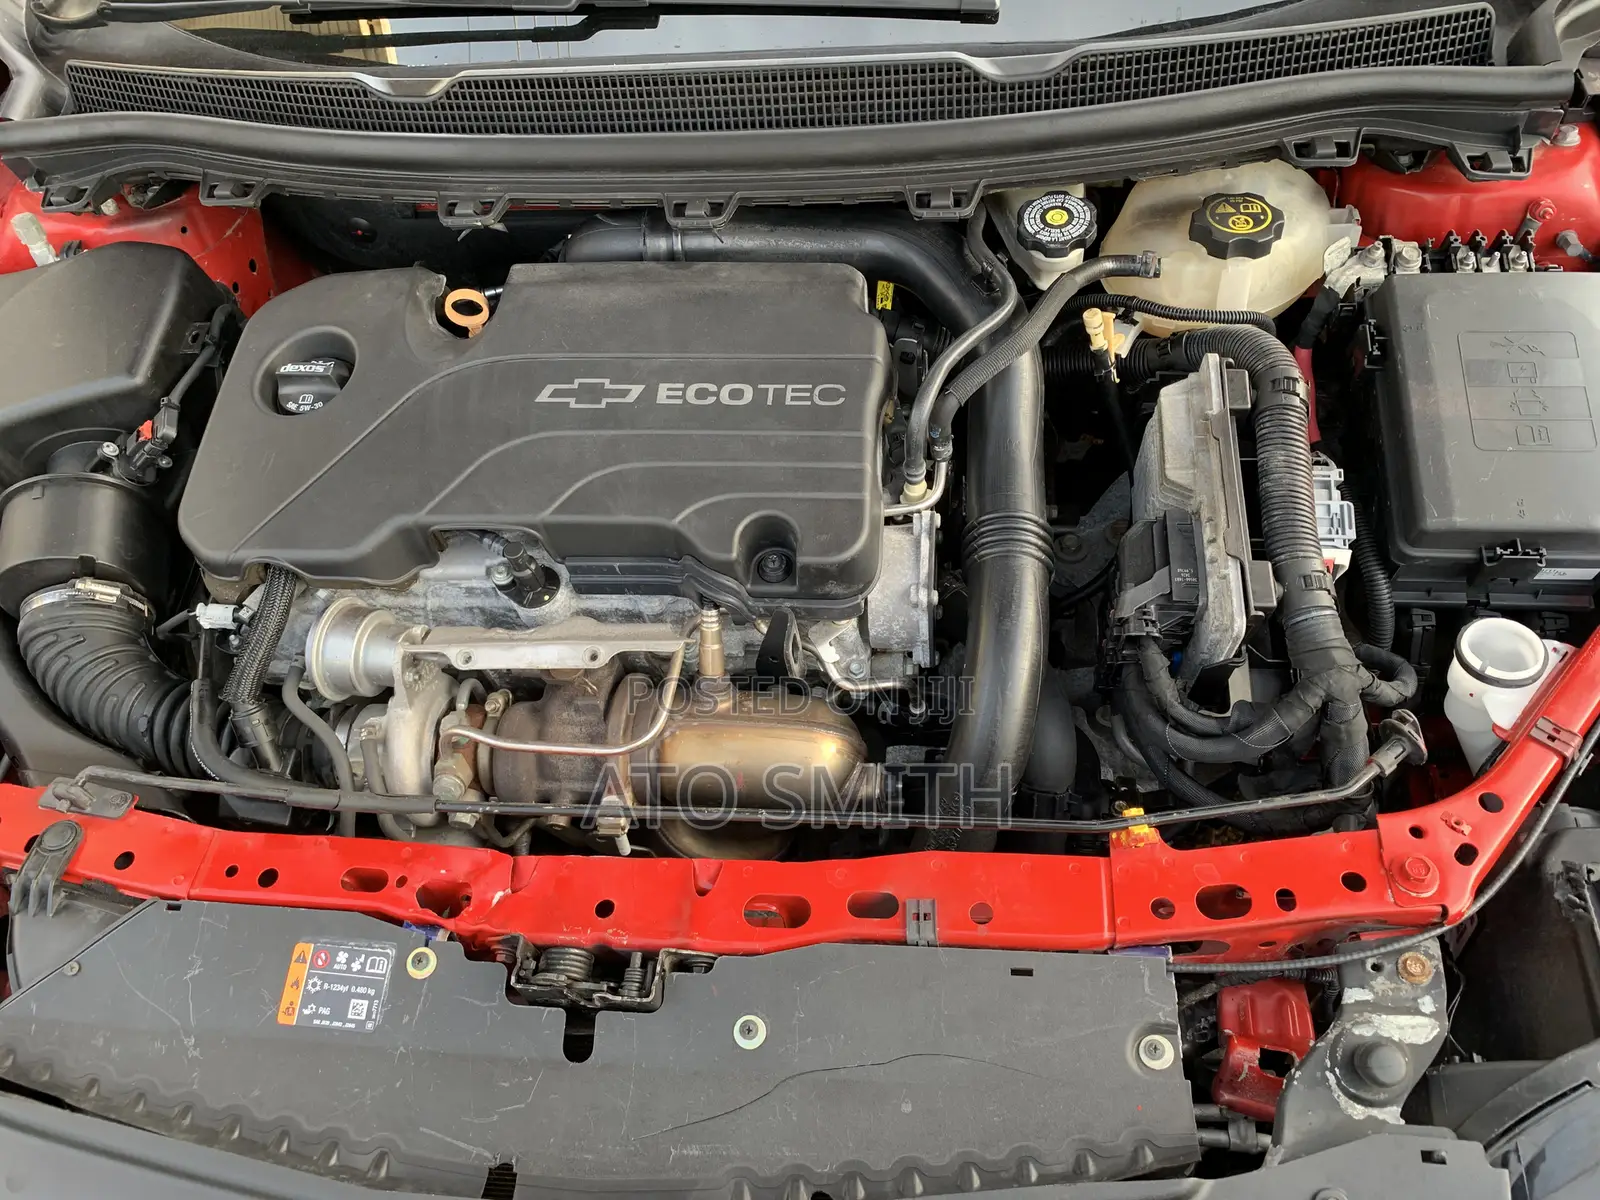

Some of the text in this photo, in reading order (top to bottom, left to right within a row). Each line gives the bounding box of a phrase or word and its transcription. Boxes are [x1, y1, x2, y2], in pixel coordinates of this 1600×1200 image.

[280, 363, 326, 373] dexos
[656, 383, 847, 406] ECOTEC
[286, 401, 323, 412] SAE 5W-30
[333, 963, 347, 971] AUTO
[323, 982, 349, 994] R-1234yf
[318, 1006, 331, 1015] PAG
